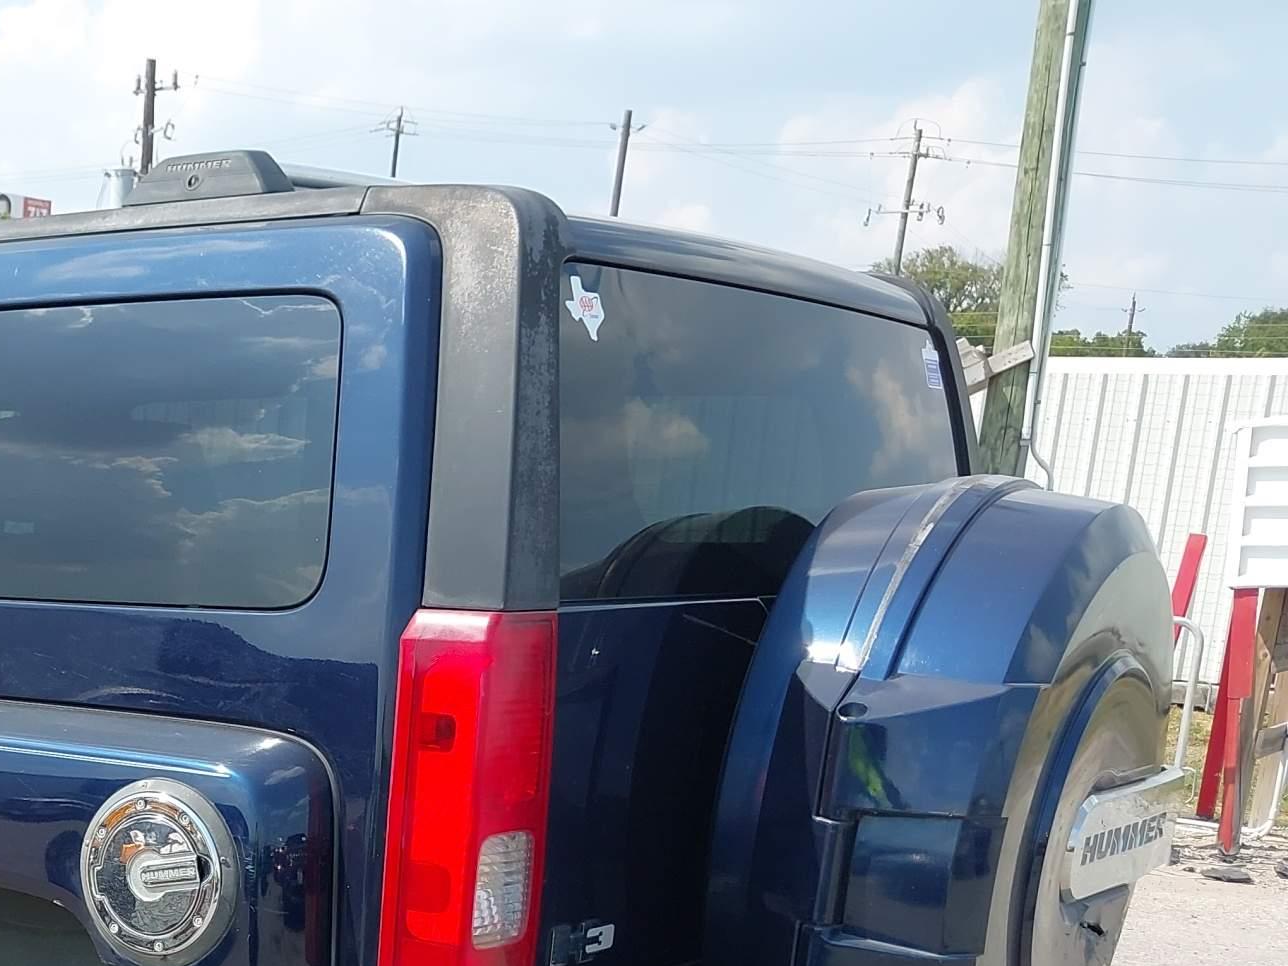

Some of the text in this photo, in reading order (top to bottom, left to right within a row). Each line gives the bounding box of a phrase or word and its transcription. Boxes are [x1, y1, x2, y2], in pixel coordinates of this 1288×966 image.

[166, 159, 232, 173] HUMMER
[1080, 812, 1167, 866] HUMMER
[141, 867, 196, 881] HUMMER
